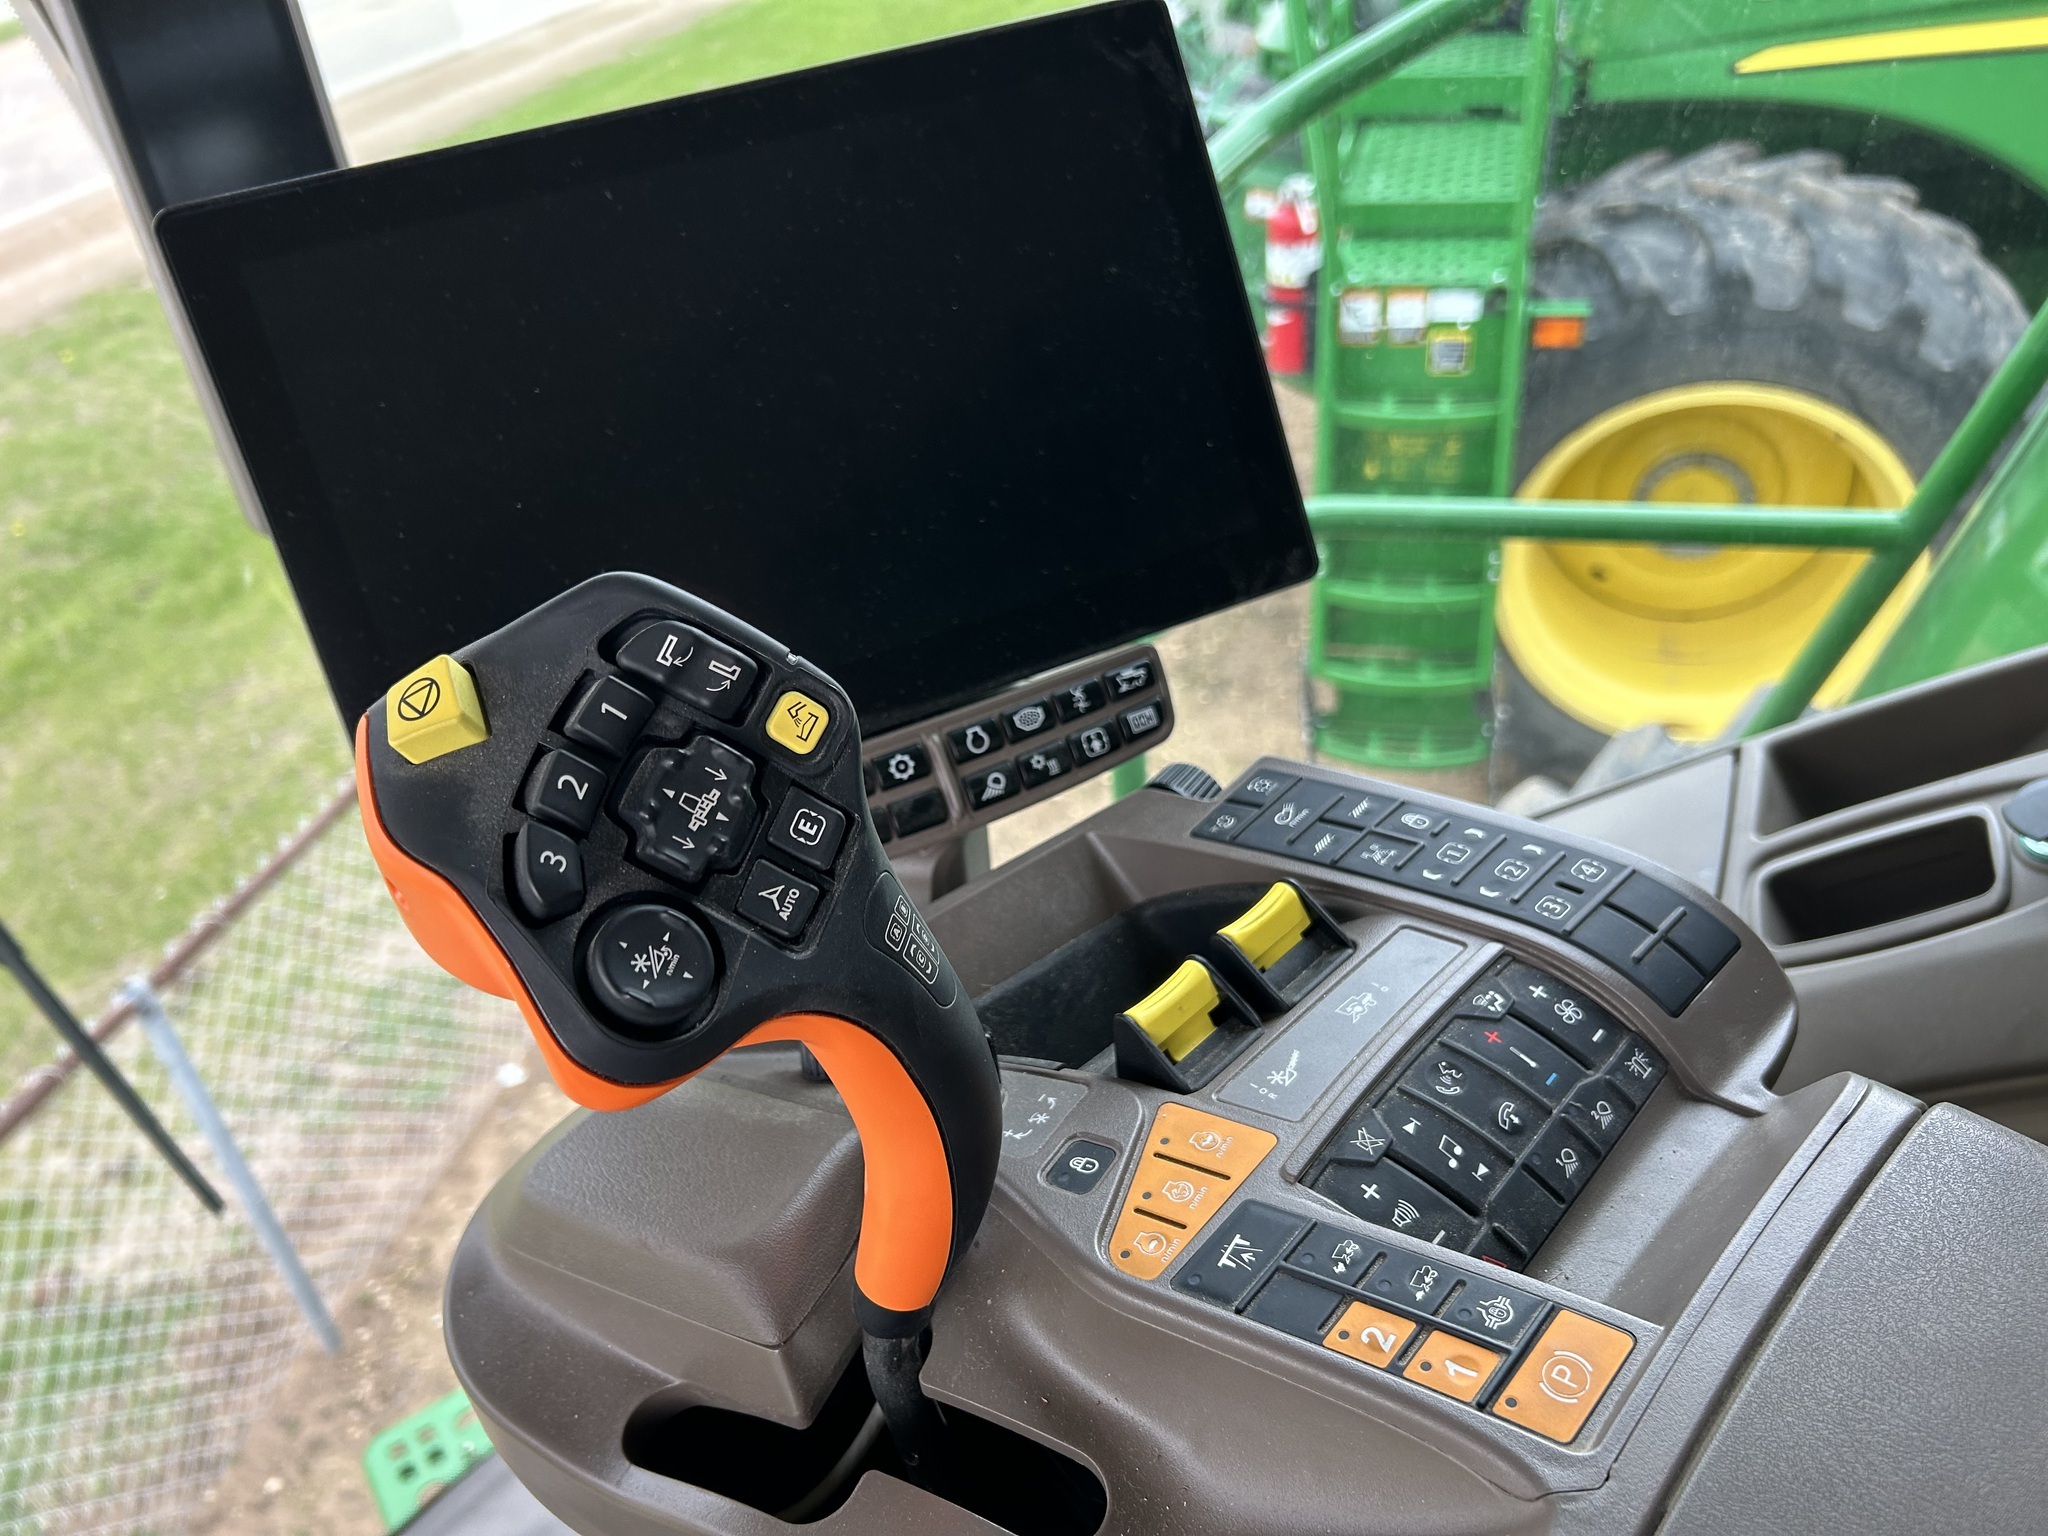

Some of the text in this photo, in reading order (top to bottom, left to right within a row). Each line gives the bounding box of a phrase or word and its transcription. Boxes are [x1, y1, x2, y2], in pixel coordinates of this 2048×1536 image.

[601, 702, 628, 721] 1
[557, 774, 589, 801] 2
[797, 818, 819, 836] E
[539, 850, 567, 873] 3
[1446, 849, 1463, 859] 1
[1503, 865, 1522, 877] 2
[1579, 863, 1599, 876] 4
[778, 888, 800, 922] AUTO
[1542, 901, 1561, 914] 3
[666, 953, 681, 977] n/min
[1590, 1109, 1600, 1121] 2
[1215, 1135, 1235, 1159] n/min
[1555, 1157, 1565, 1167] 1
[1189, 1185, 1209, 1210] n/min
[1160, 1237, 1182, 1264] n/min
[1360, 1325, 1398, 1355] 2
[1443, 1358, 1479, 1378] 1
[1550, 1363, 1579, 1389] P
